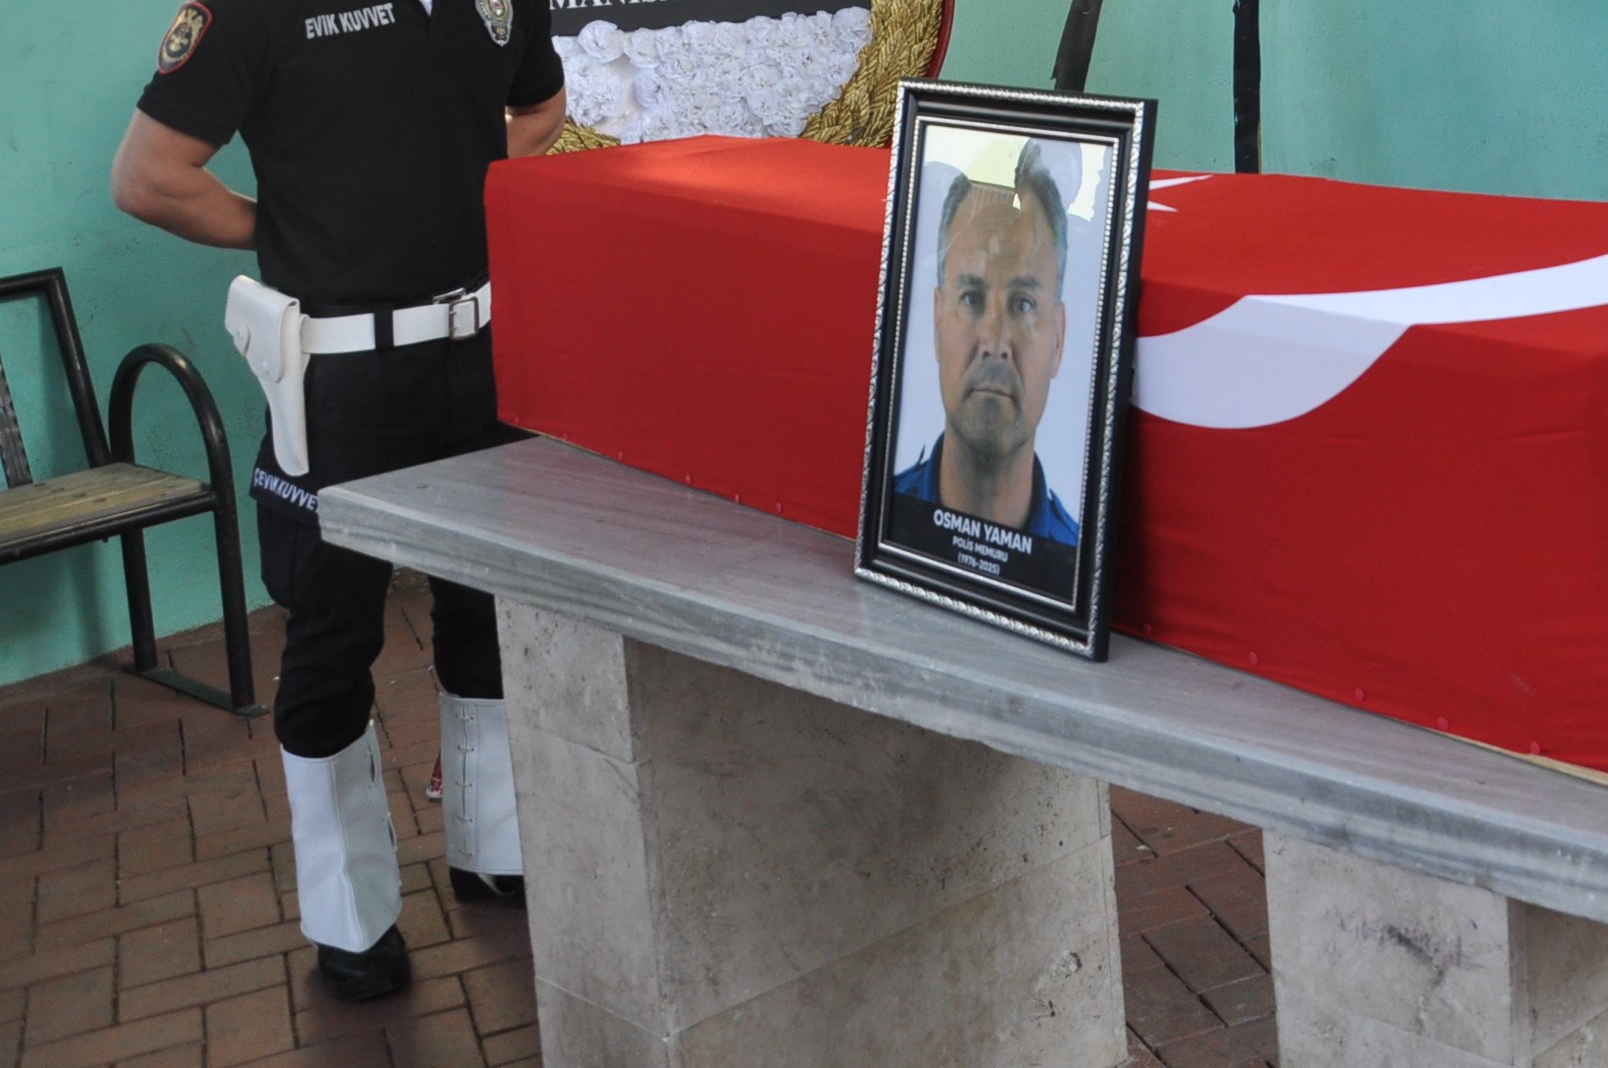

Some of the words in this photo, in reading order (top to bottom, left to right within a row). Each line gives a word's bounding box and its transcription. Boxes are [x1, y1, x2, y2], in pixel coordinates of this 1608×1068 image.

[338, 2, 396, 33] KUVVET
[933, 509, 981, 538] OSMAN
[983, 523, 1032, 554] YAMAN
[952, 535, 974, 552] POLİS
